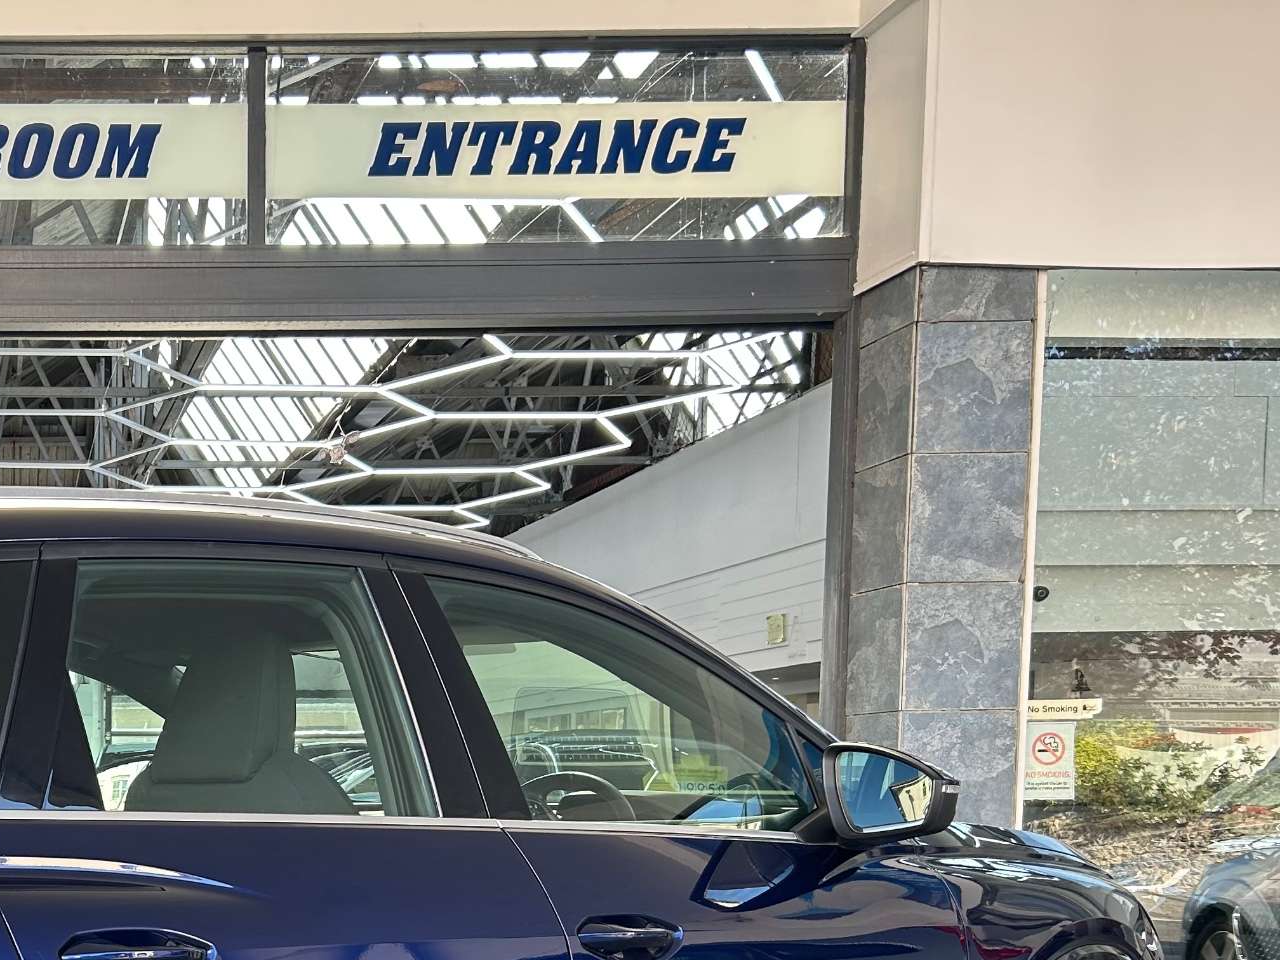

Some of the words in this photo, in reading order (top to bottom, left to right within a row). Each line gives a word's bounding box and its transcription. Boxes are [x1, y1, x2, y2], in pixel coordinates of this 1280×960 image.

[367, 117, 747, 177] ENTRANCE
[1027, 705, 1040, 713] No
[1042, 705, 1078, 713] Smoking
